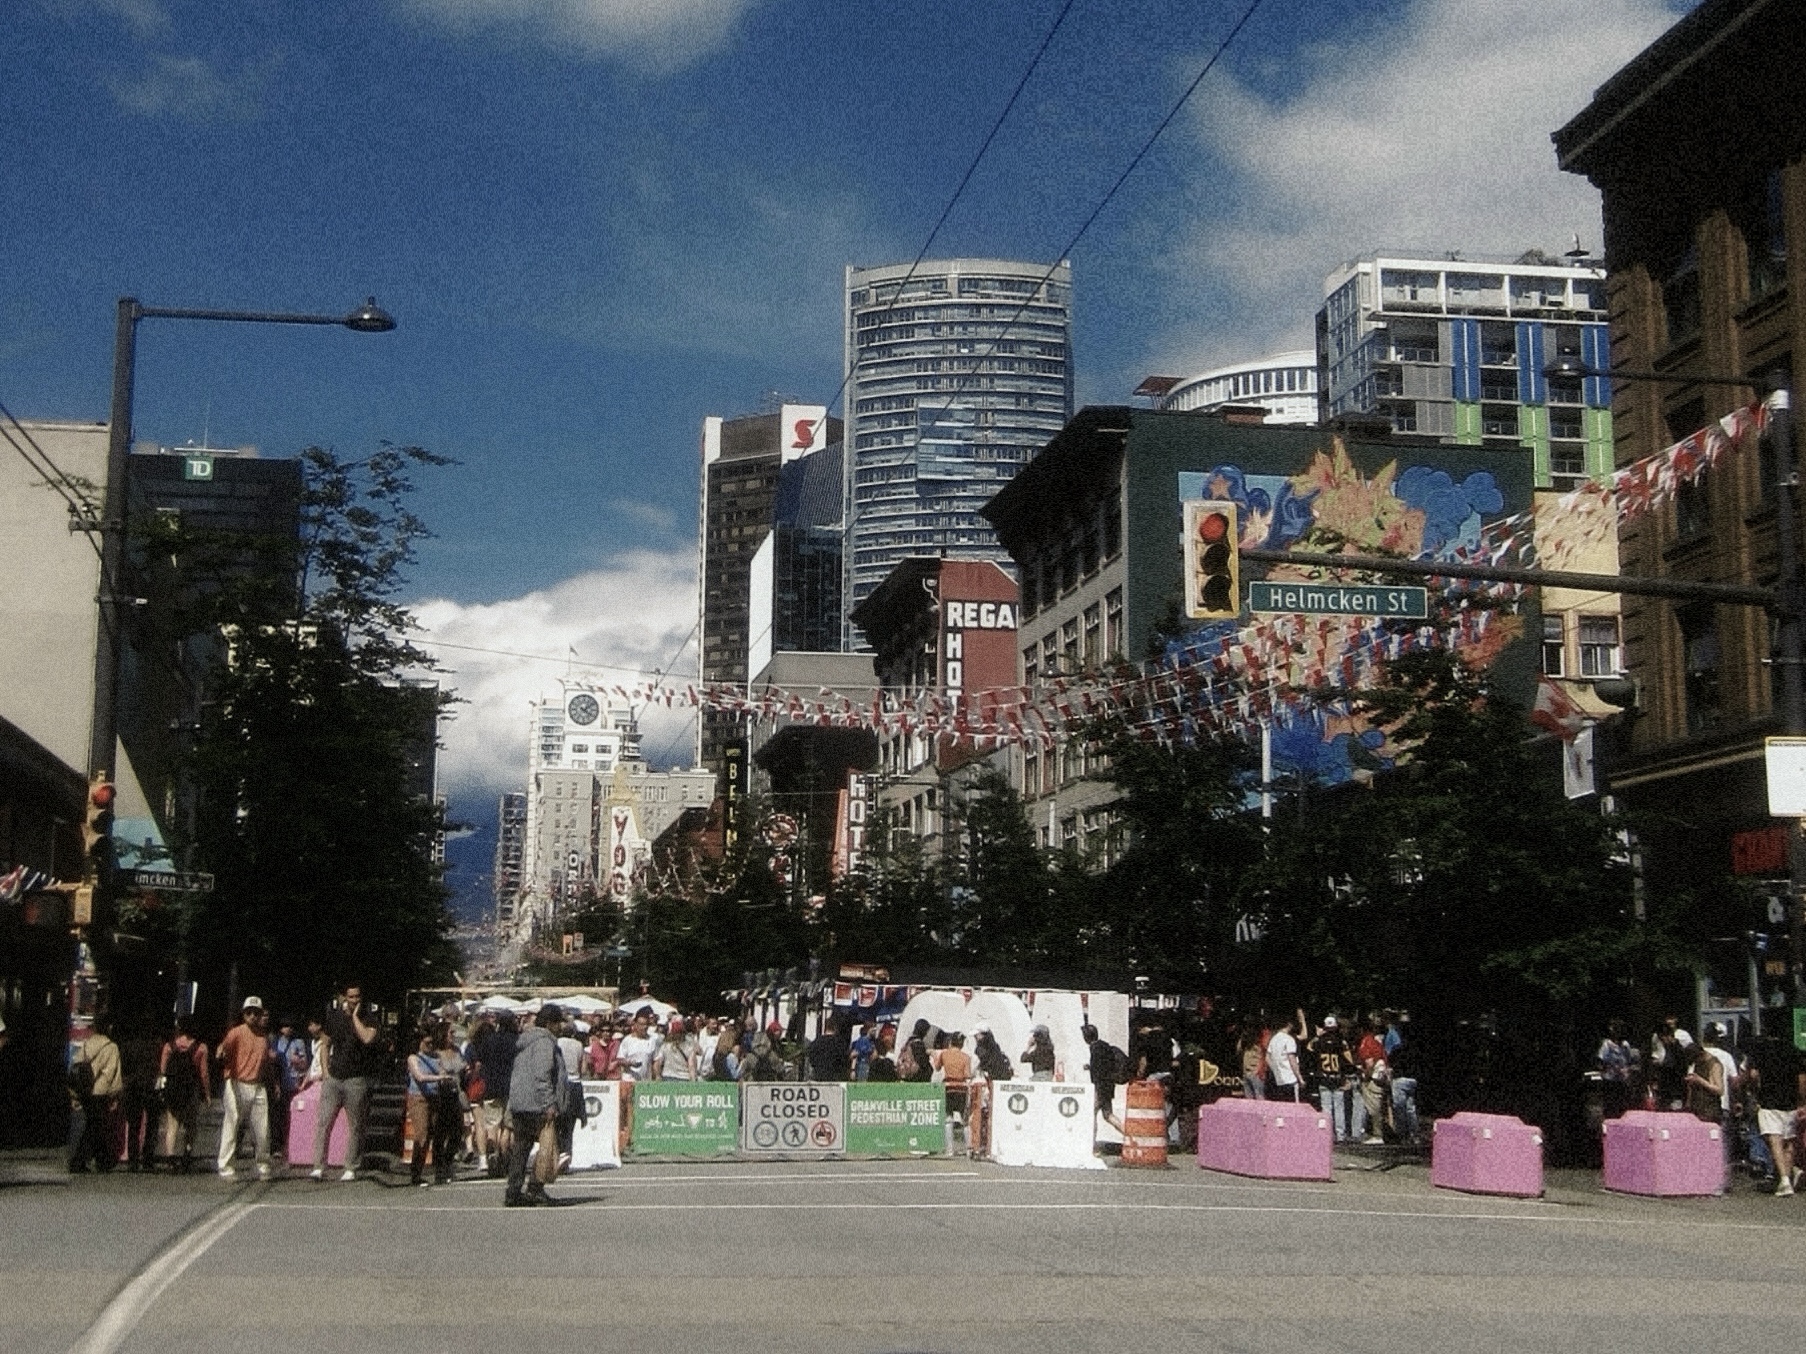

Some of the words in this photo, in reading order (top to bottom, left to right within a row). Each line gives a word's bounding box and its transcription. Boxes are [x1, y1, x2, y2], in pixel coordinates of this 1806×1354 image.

[188, 459, 211, 476] TD
[1269, 588, 1378, 612] Helmcken
[1387, 592, 1409, 613] St
[946, 601, 1020, 629] REGA
[1320, 1053, 1339, 1073] 20
[639, 1094, 669, 1109] SLOW
[674, 1094, 703, 1109] YOUR
[706, 1094, 734, 1109] ROLL
[770, 1087, 820, 1102] ROAD
[760, 1104, 830, 1119] CLOSED
[850, 1100, 903, 1112] GRANVILLE
[905, 1099, 941, 1111] STREET
[850, 1112, 908, 1123] PEDESTRIAN
[910, 1112, 940, 1125] ZONE
